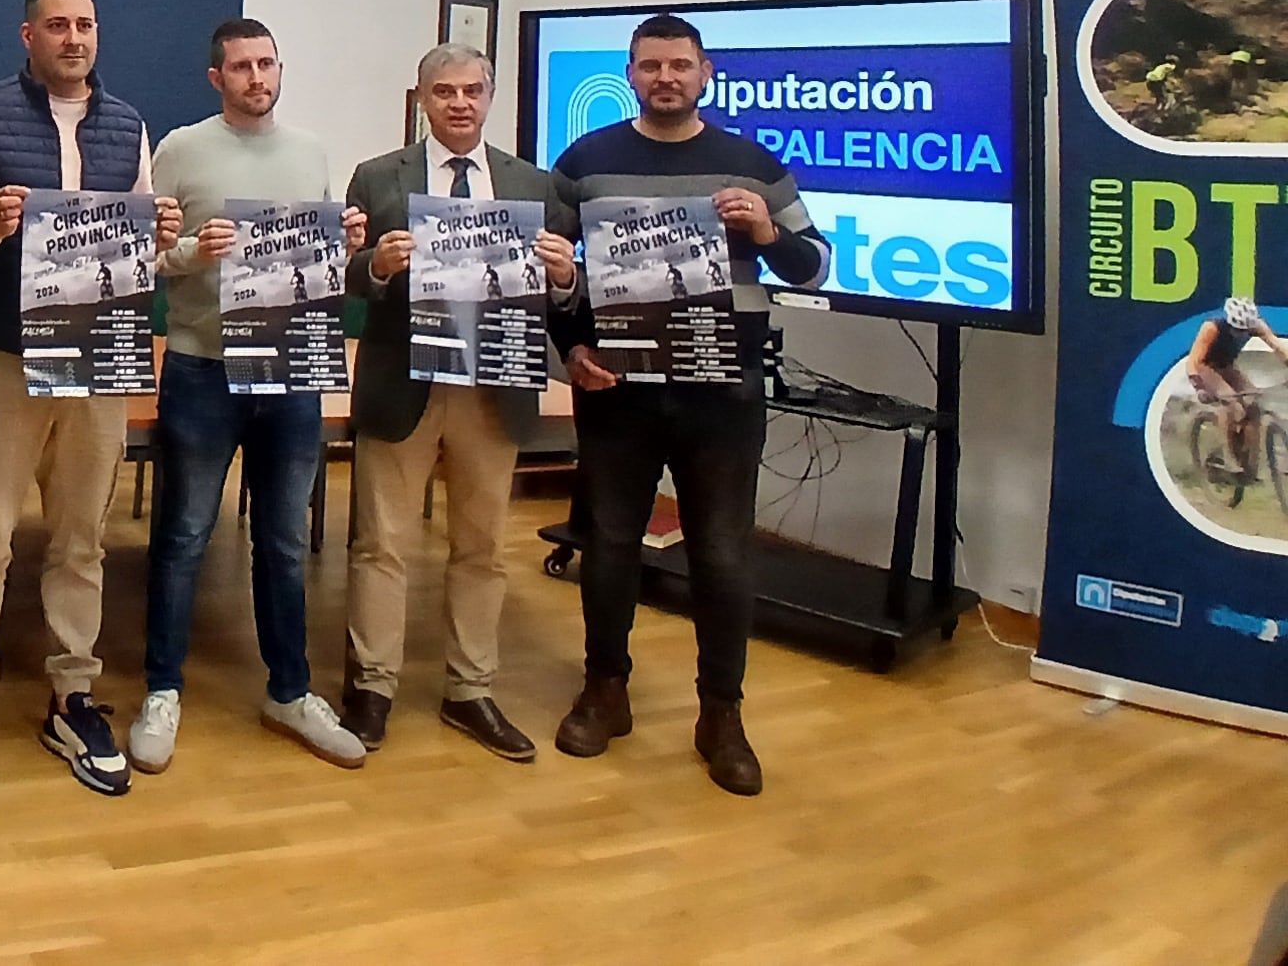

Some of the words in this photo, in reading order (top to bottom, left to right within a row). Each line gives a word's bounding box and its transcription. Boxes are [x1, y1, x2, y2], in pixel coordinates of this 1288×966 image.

[756, 128, 1002, 173] PALENCIA
[53, 201, 126, 232] CIRCUITO
[251, 210, 318, 239] CIRCUITO
[437, 209, 510, 234] CIRCUITO
[613, 206, 687, 238] CIRCUITO
[46, 219, 139, 255] PROVINCIAL
[121, 237, 150, 257] BTT
[243, 227, 330, 260] PROVINCIAL
[431, 226, 526, 253] PROVINCIAL
[609, 223, 707, 259] PROVINCIAL
[689, 239, 720, 258] BTT
[1088, 177, 1124, 298] CIRCUITO
[1130, 180, 1288, 303] BT
[314, 244, 340, 263] BTT
[36, 285, 60, 299] 2026
[233, 289, 257, 302] 2026
[603, 285, 628, 298] 2026
